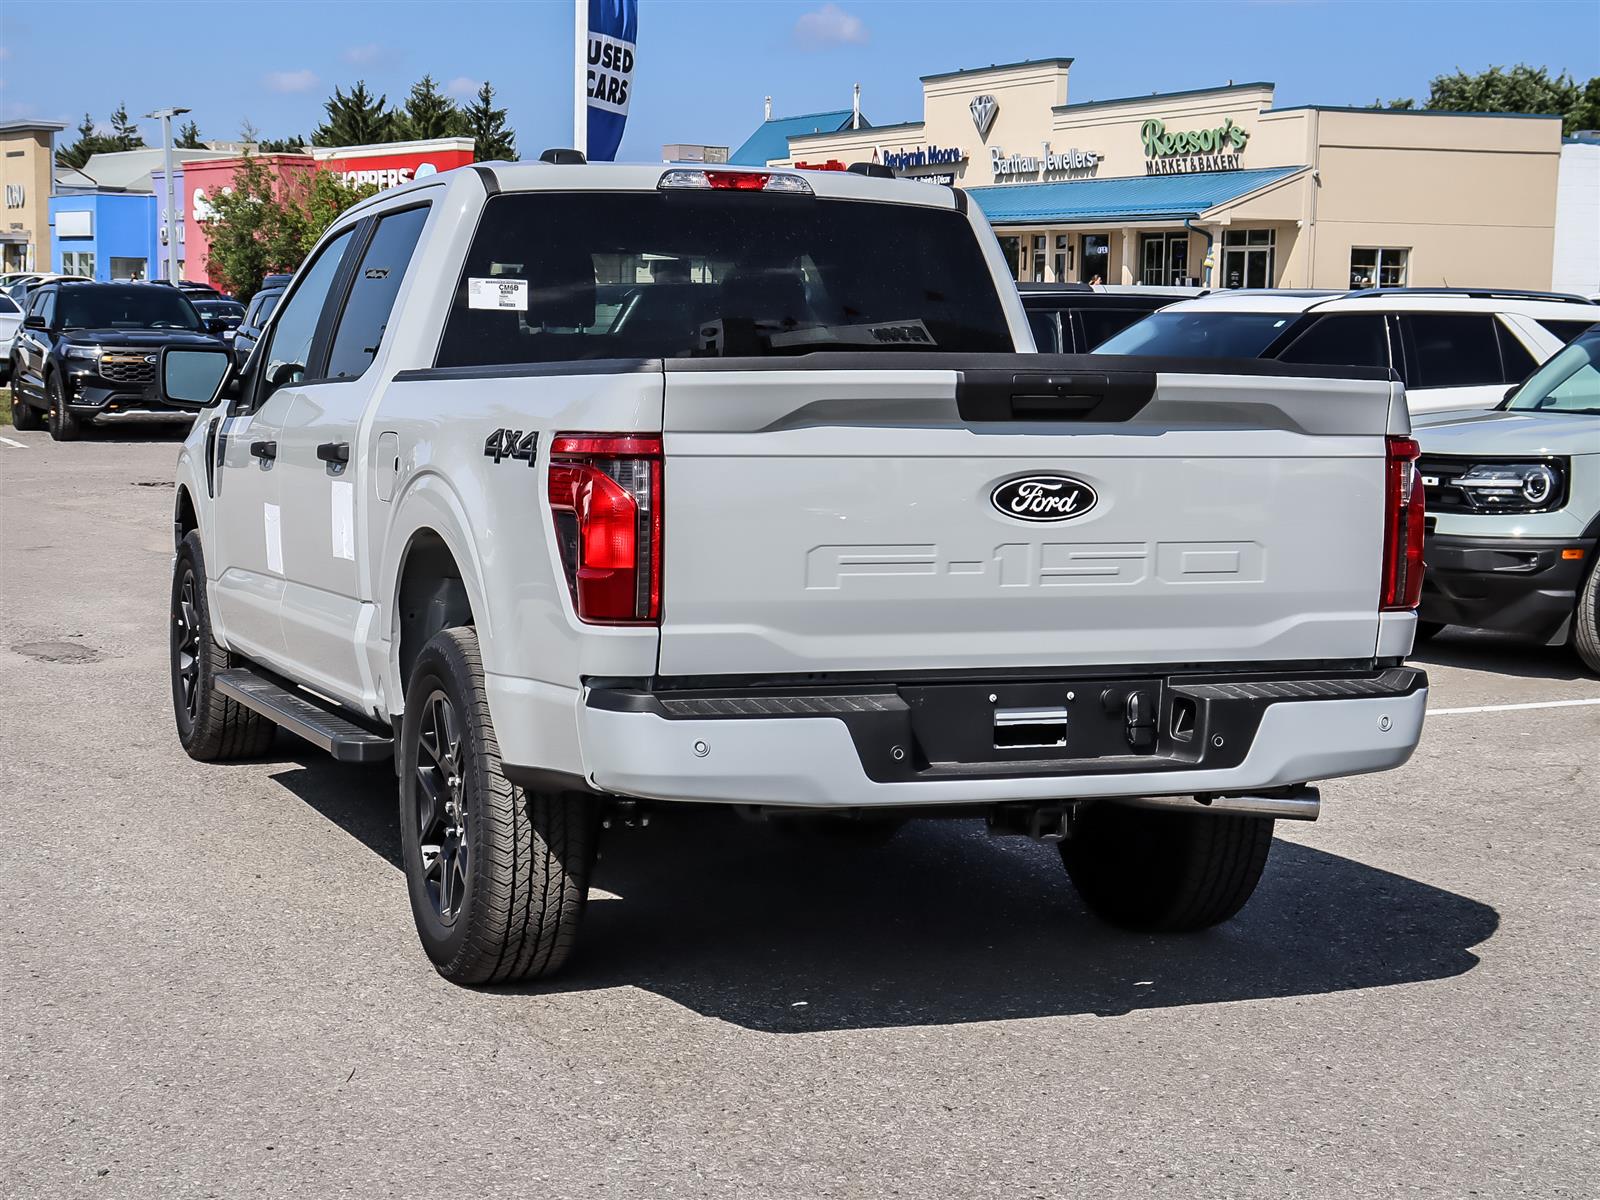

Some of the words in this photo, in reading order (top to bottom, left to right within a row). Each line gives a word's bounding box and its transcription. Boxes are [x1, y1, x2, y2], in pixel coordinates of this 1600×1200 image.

[587, 39, 634, 73] USED
[587, 69, 629, 105] CARS
[1140, 116, 1246, 156] Reesor's
[883, 146, 926, 171] Benjamin
[928, 144, 960, 165] Moore
[989, 146, 1037, 175] Barthau
[1040, 141, 1098, 171] Jewellers
[332, 167, 412, 194] HOPPERS
[1011, 481, 1080, 513] Ford
[804, 540, 1269, 590] F-150
